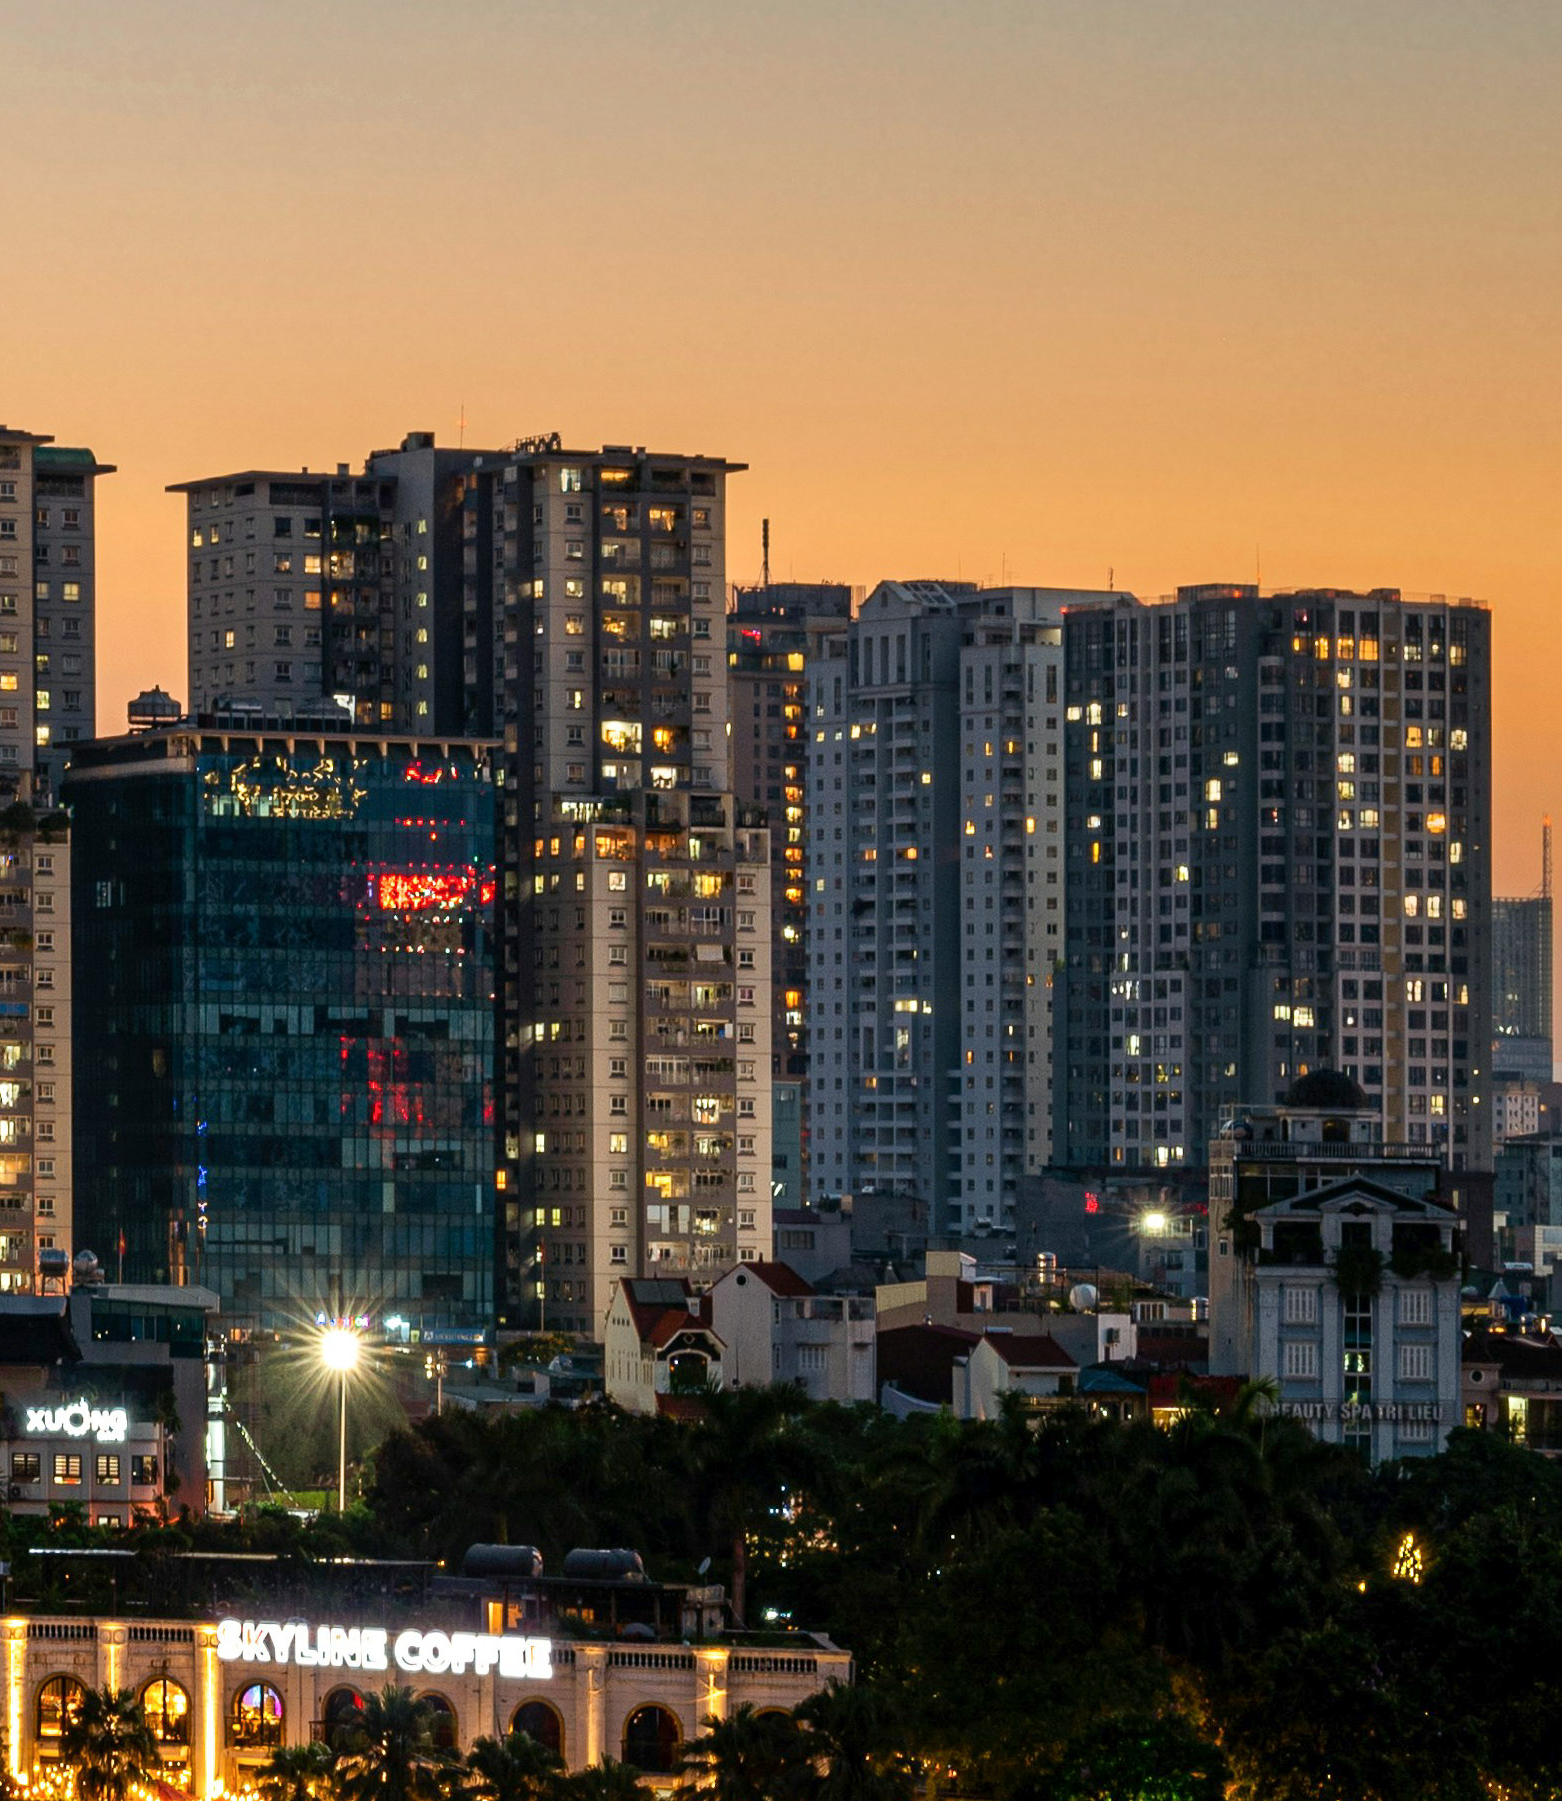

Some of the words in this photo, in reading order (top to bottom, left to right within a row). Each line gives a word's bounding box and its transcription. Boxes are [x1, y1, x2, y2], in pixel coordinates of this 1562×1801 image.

[1340, 1403, 1372, 1420] SPA
[217, 1619, 388, 1670] SKYLINE
[395, 1629, 553, 1679] COFFEE
